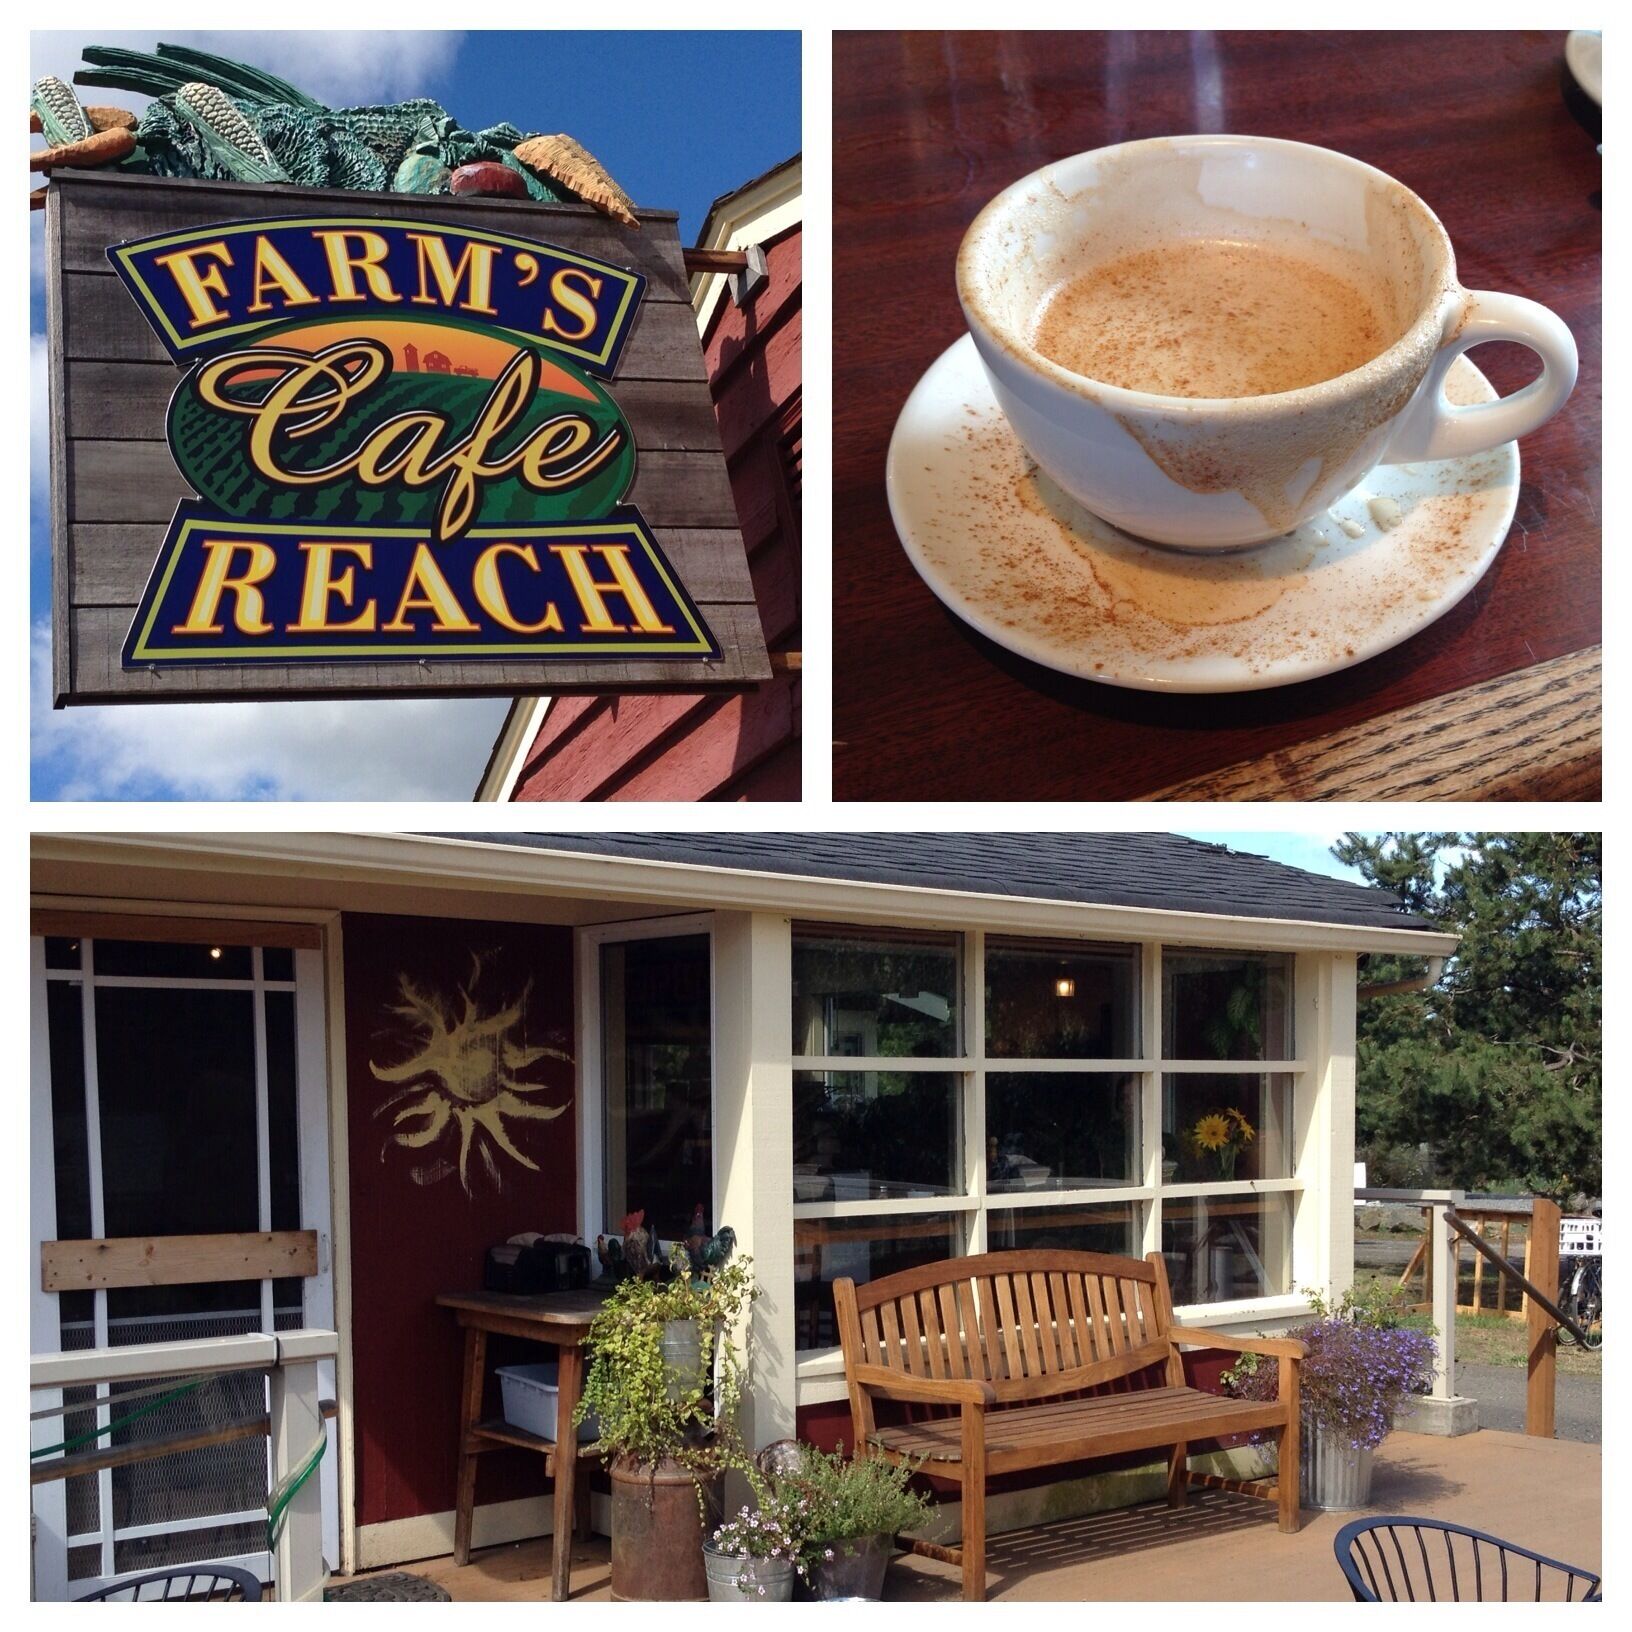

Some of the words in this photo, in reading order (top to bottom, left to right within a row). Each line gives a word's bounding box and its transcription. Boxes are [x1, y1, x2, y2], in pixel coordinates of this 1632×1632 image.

[156, 229, 603, 340] FARM'S
[197, 338, 622, 541] Cafe
[171, 540, 675, 634] REACH
